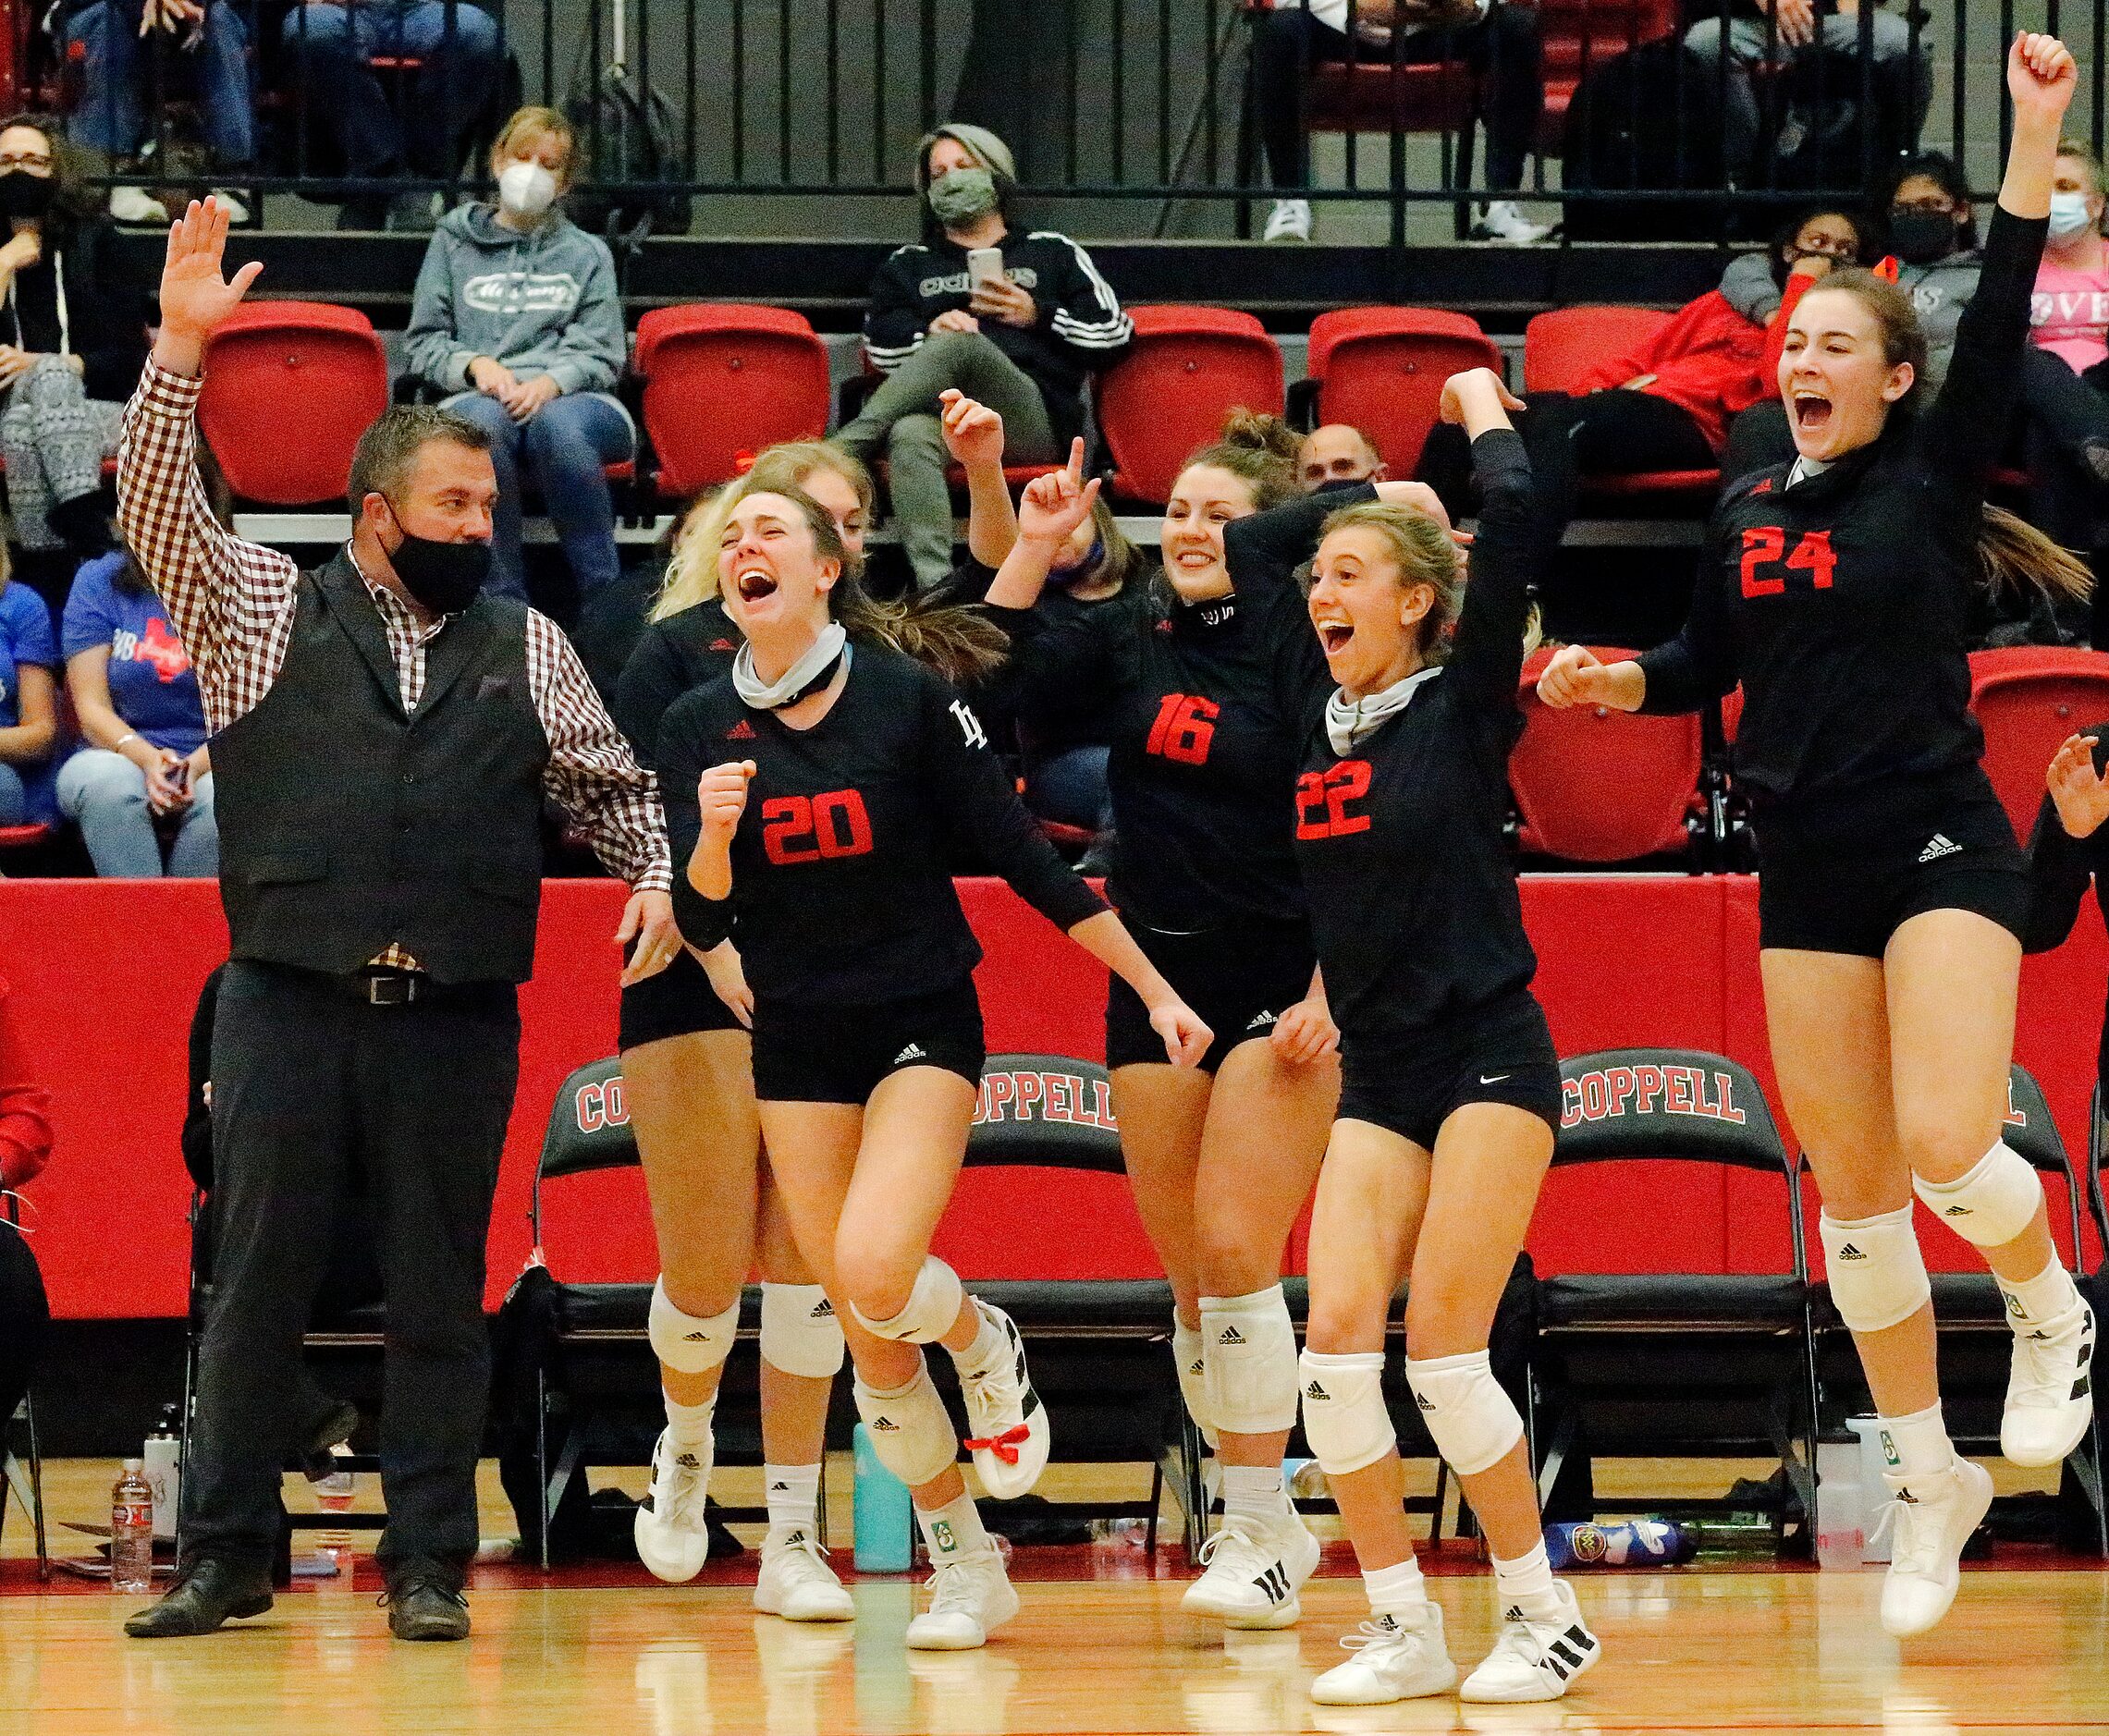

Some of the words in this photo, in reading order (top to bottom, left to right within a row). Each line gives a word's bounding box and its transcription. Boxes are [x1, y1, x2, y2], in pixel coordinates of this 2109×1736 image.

[1741, 525, 1837, 598] 24
[1146, 693, 1220, 766] 16
[762, 789, 873, 865] 20
[1295, 760, 1372, 840] 22
[1919, 845, 1963, 862] adidas
[894, 1050, 926, 1064] adidas
[1560, 1065, 1746, 1130] COPPELL
